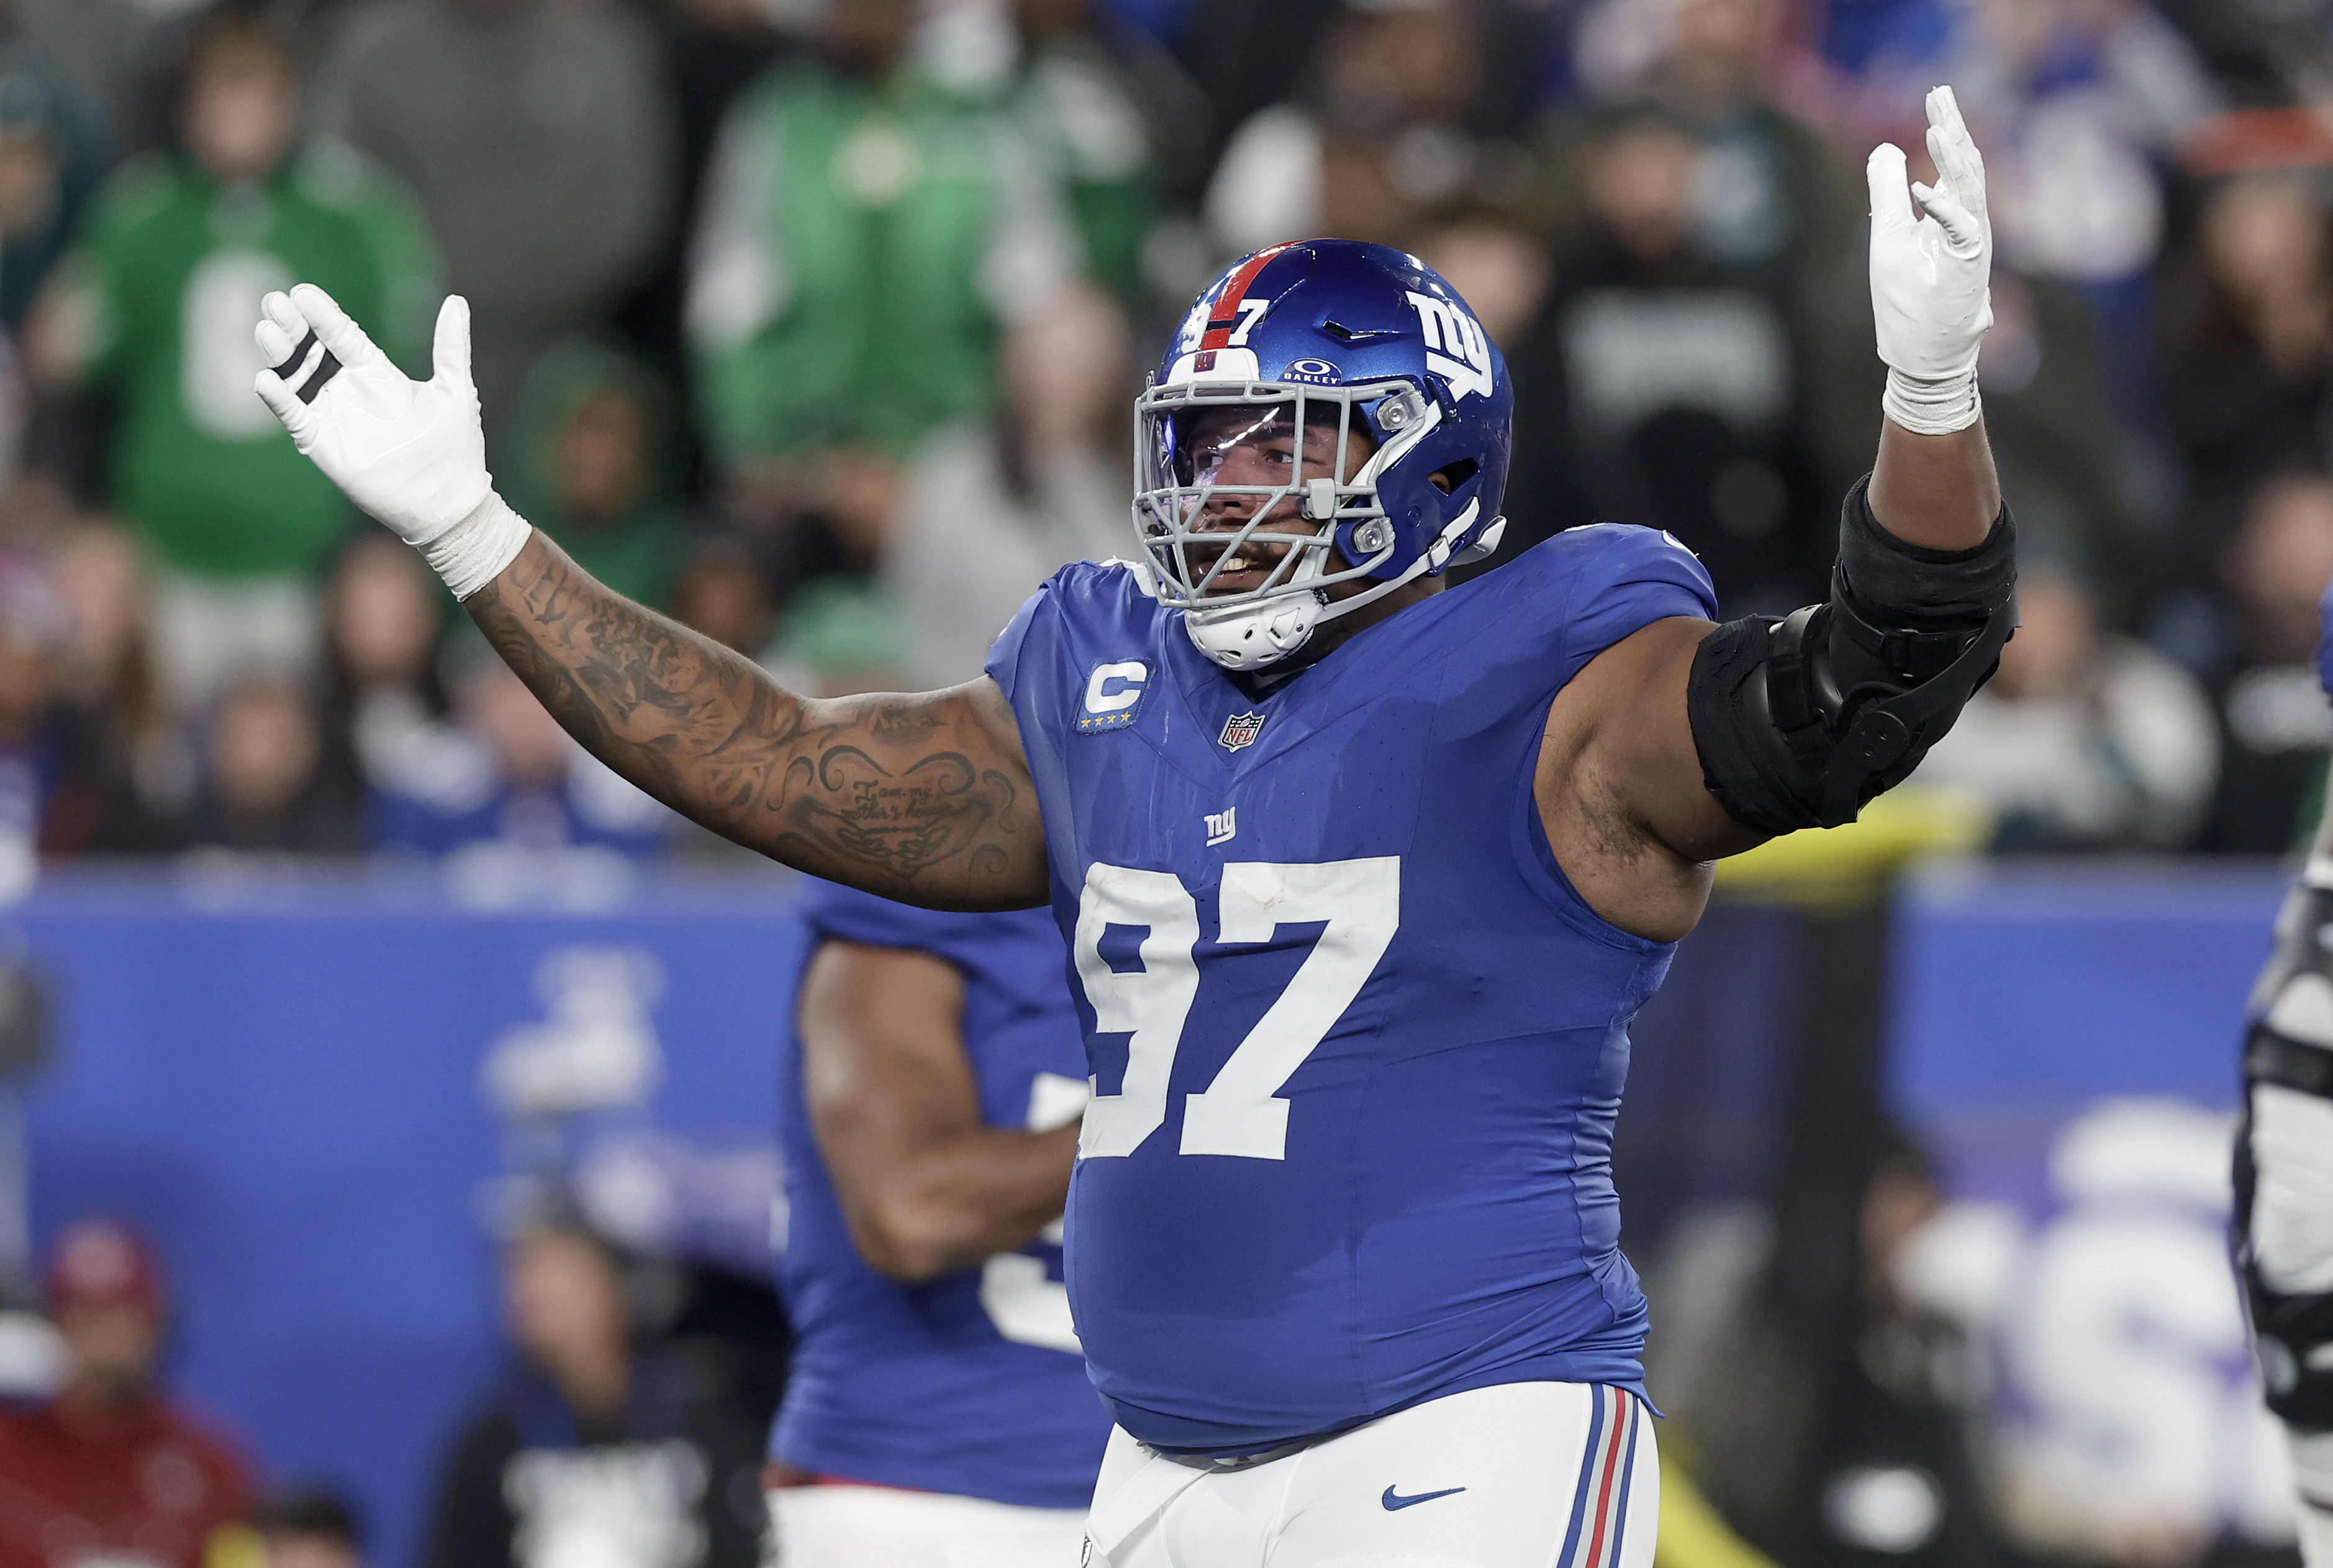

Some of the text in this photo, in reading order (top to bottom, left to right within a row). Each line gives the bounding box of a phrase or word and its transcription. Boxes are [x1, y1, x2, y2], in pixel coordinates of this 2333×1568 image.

[1181, 299, 1270, 354] 97
[1284, 373, 1339, 384] OAKLEY
[1084, 660, 1148, 714] C
[1226, 729, 1252, 744] NFL
[1073, 855, 1400, 1160] 97
